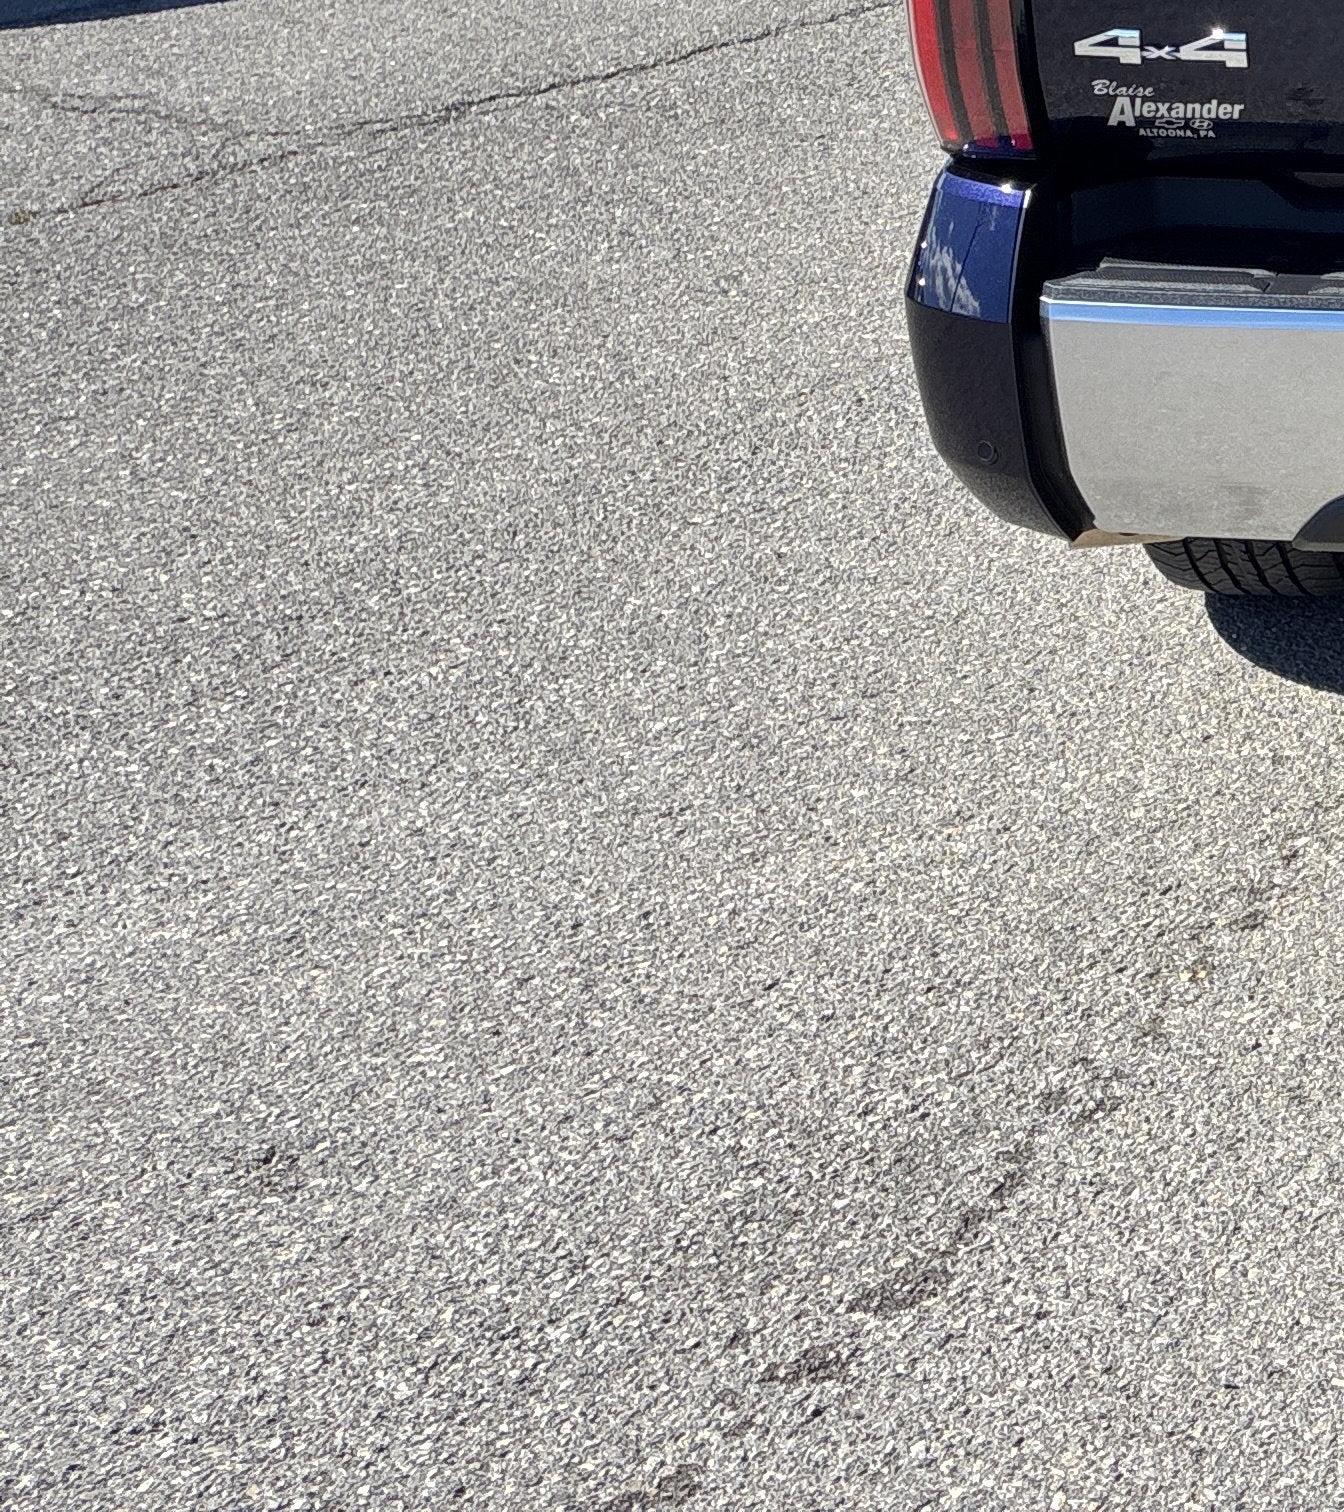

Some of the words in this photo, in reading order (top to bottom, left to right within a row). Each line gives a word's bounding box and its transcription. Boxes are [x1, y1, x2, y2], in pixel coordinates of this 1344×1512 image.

[1073, 27, 1249, 68] 4x4
[1090, 78, 1155, 97] Blaise
[1106, 96, 1245, 127] Alexander
[1138, 128, 1198, 139] ALTOONA,
[1199, 129, 1216, 139] PA
